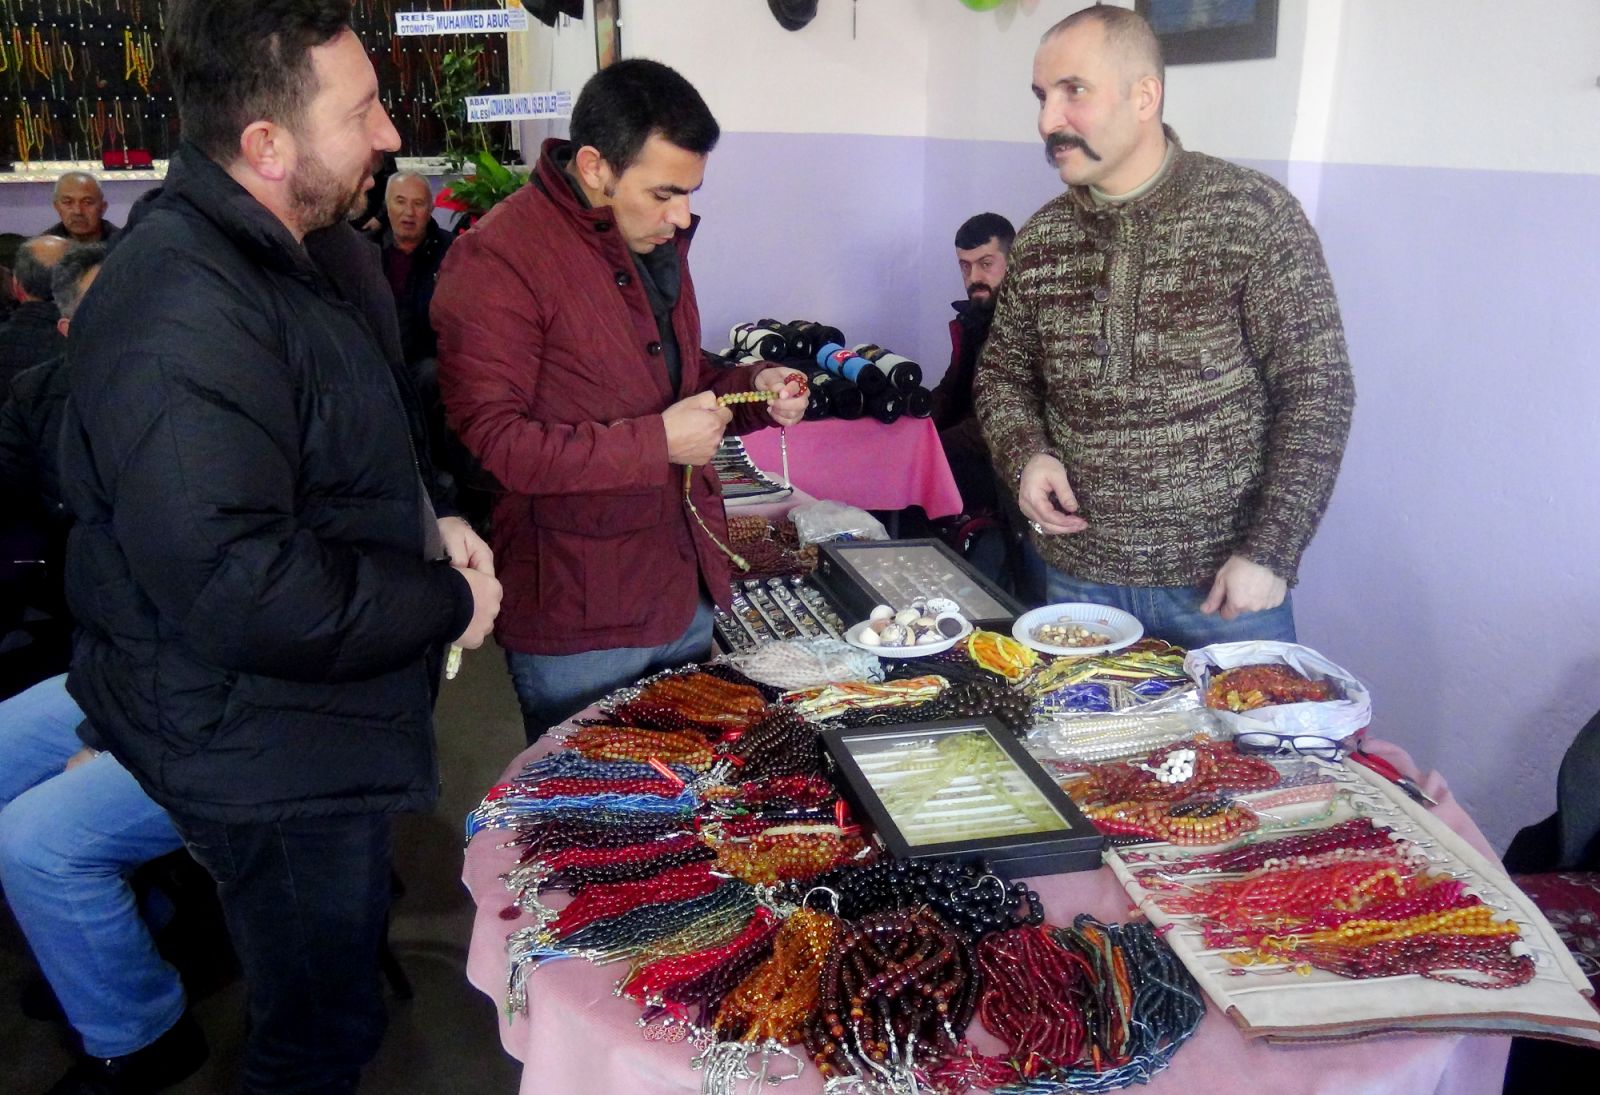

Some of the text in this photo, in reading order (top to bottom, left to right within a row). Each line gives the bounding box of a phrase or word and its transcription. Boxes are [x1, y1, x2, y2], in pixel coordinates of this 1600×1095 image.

[400, 12, 435, 21] REİS
[436, 15, 484, 29] MUHAMMED
[487, 13, 510, 28] ABUR
[469, 98, 489, 106] ABAY
